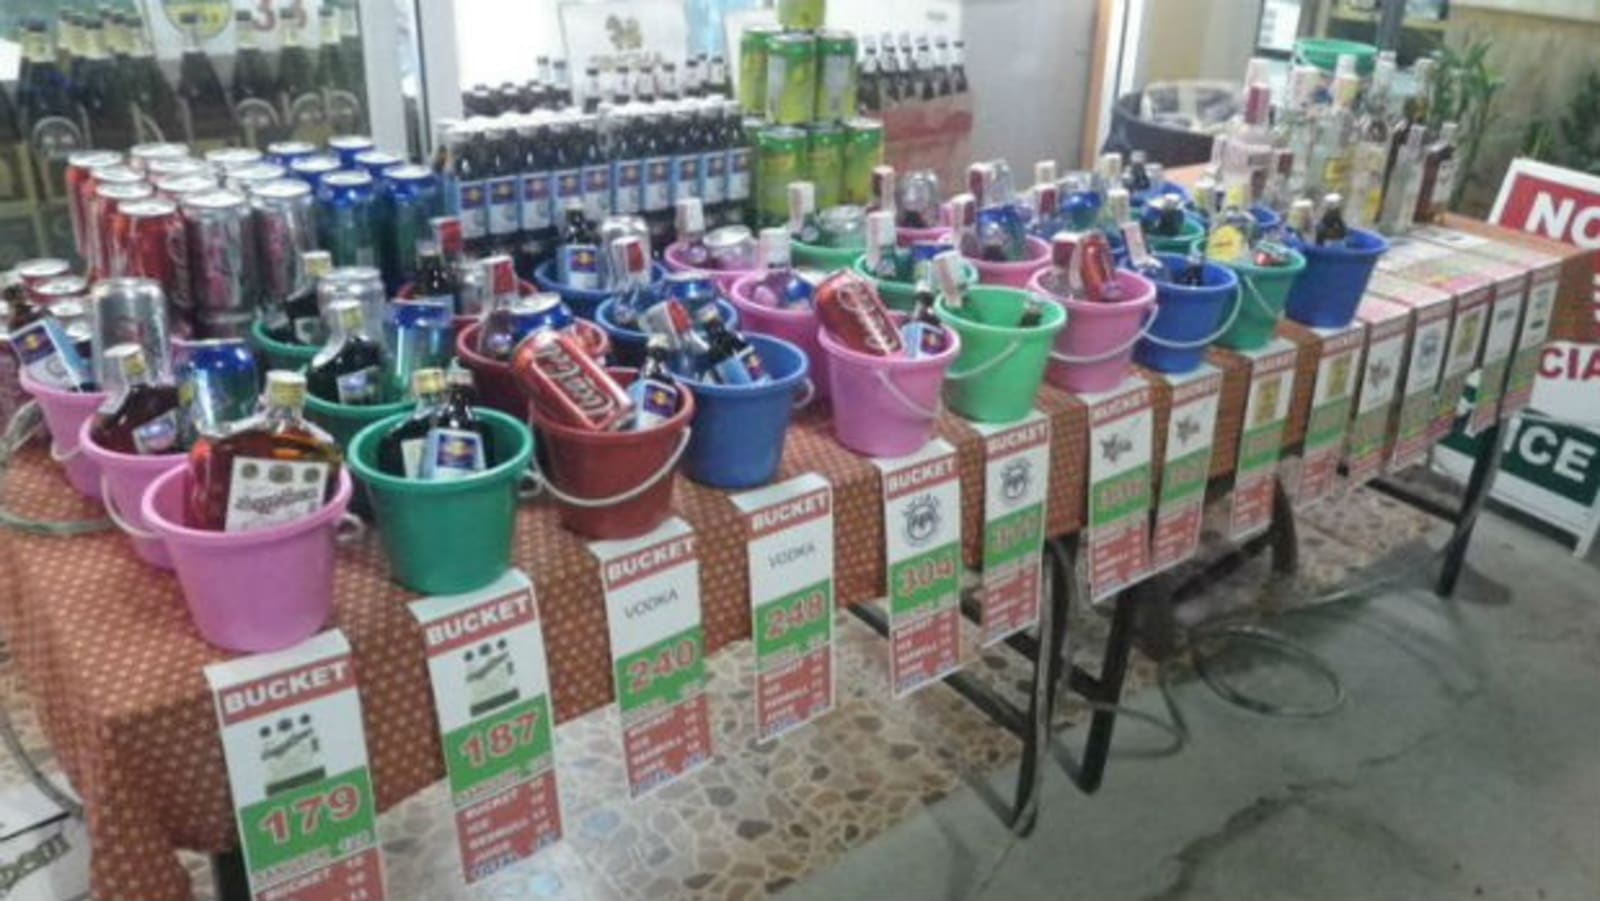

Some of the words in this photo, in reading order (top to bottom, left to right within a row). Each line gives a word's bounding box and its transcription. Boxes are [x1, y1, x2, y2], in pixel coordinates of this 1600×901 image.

[888, 456, 954, 492] BUCKET
[752, 489, 829, 532] BUCKET
[607, 535, 696, 583] BUCKET
[768, 543, 816, 568] VODKA
[425, 593, 530, 645] BUCKET
[624, 588, 679, 619] VODKA
[223, 661, 348, 715] BUCKET
[459, 709, 539, 768] 187
[258, 783, 361, 845] 179
